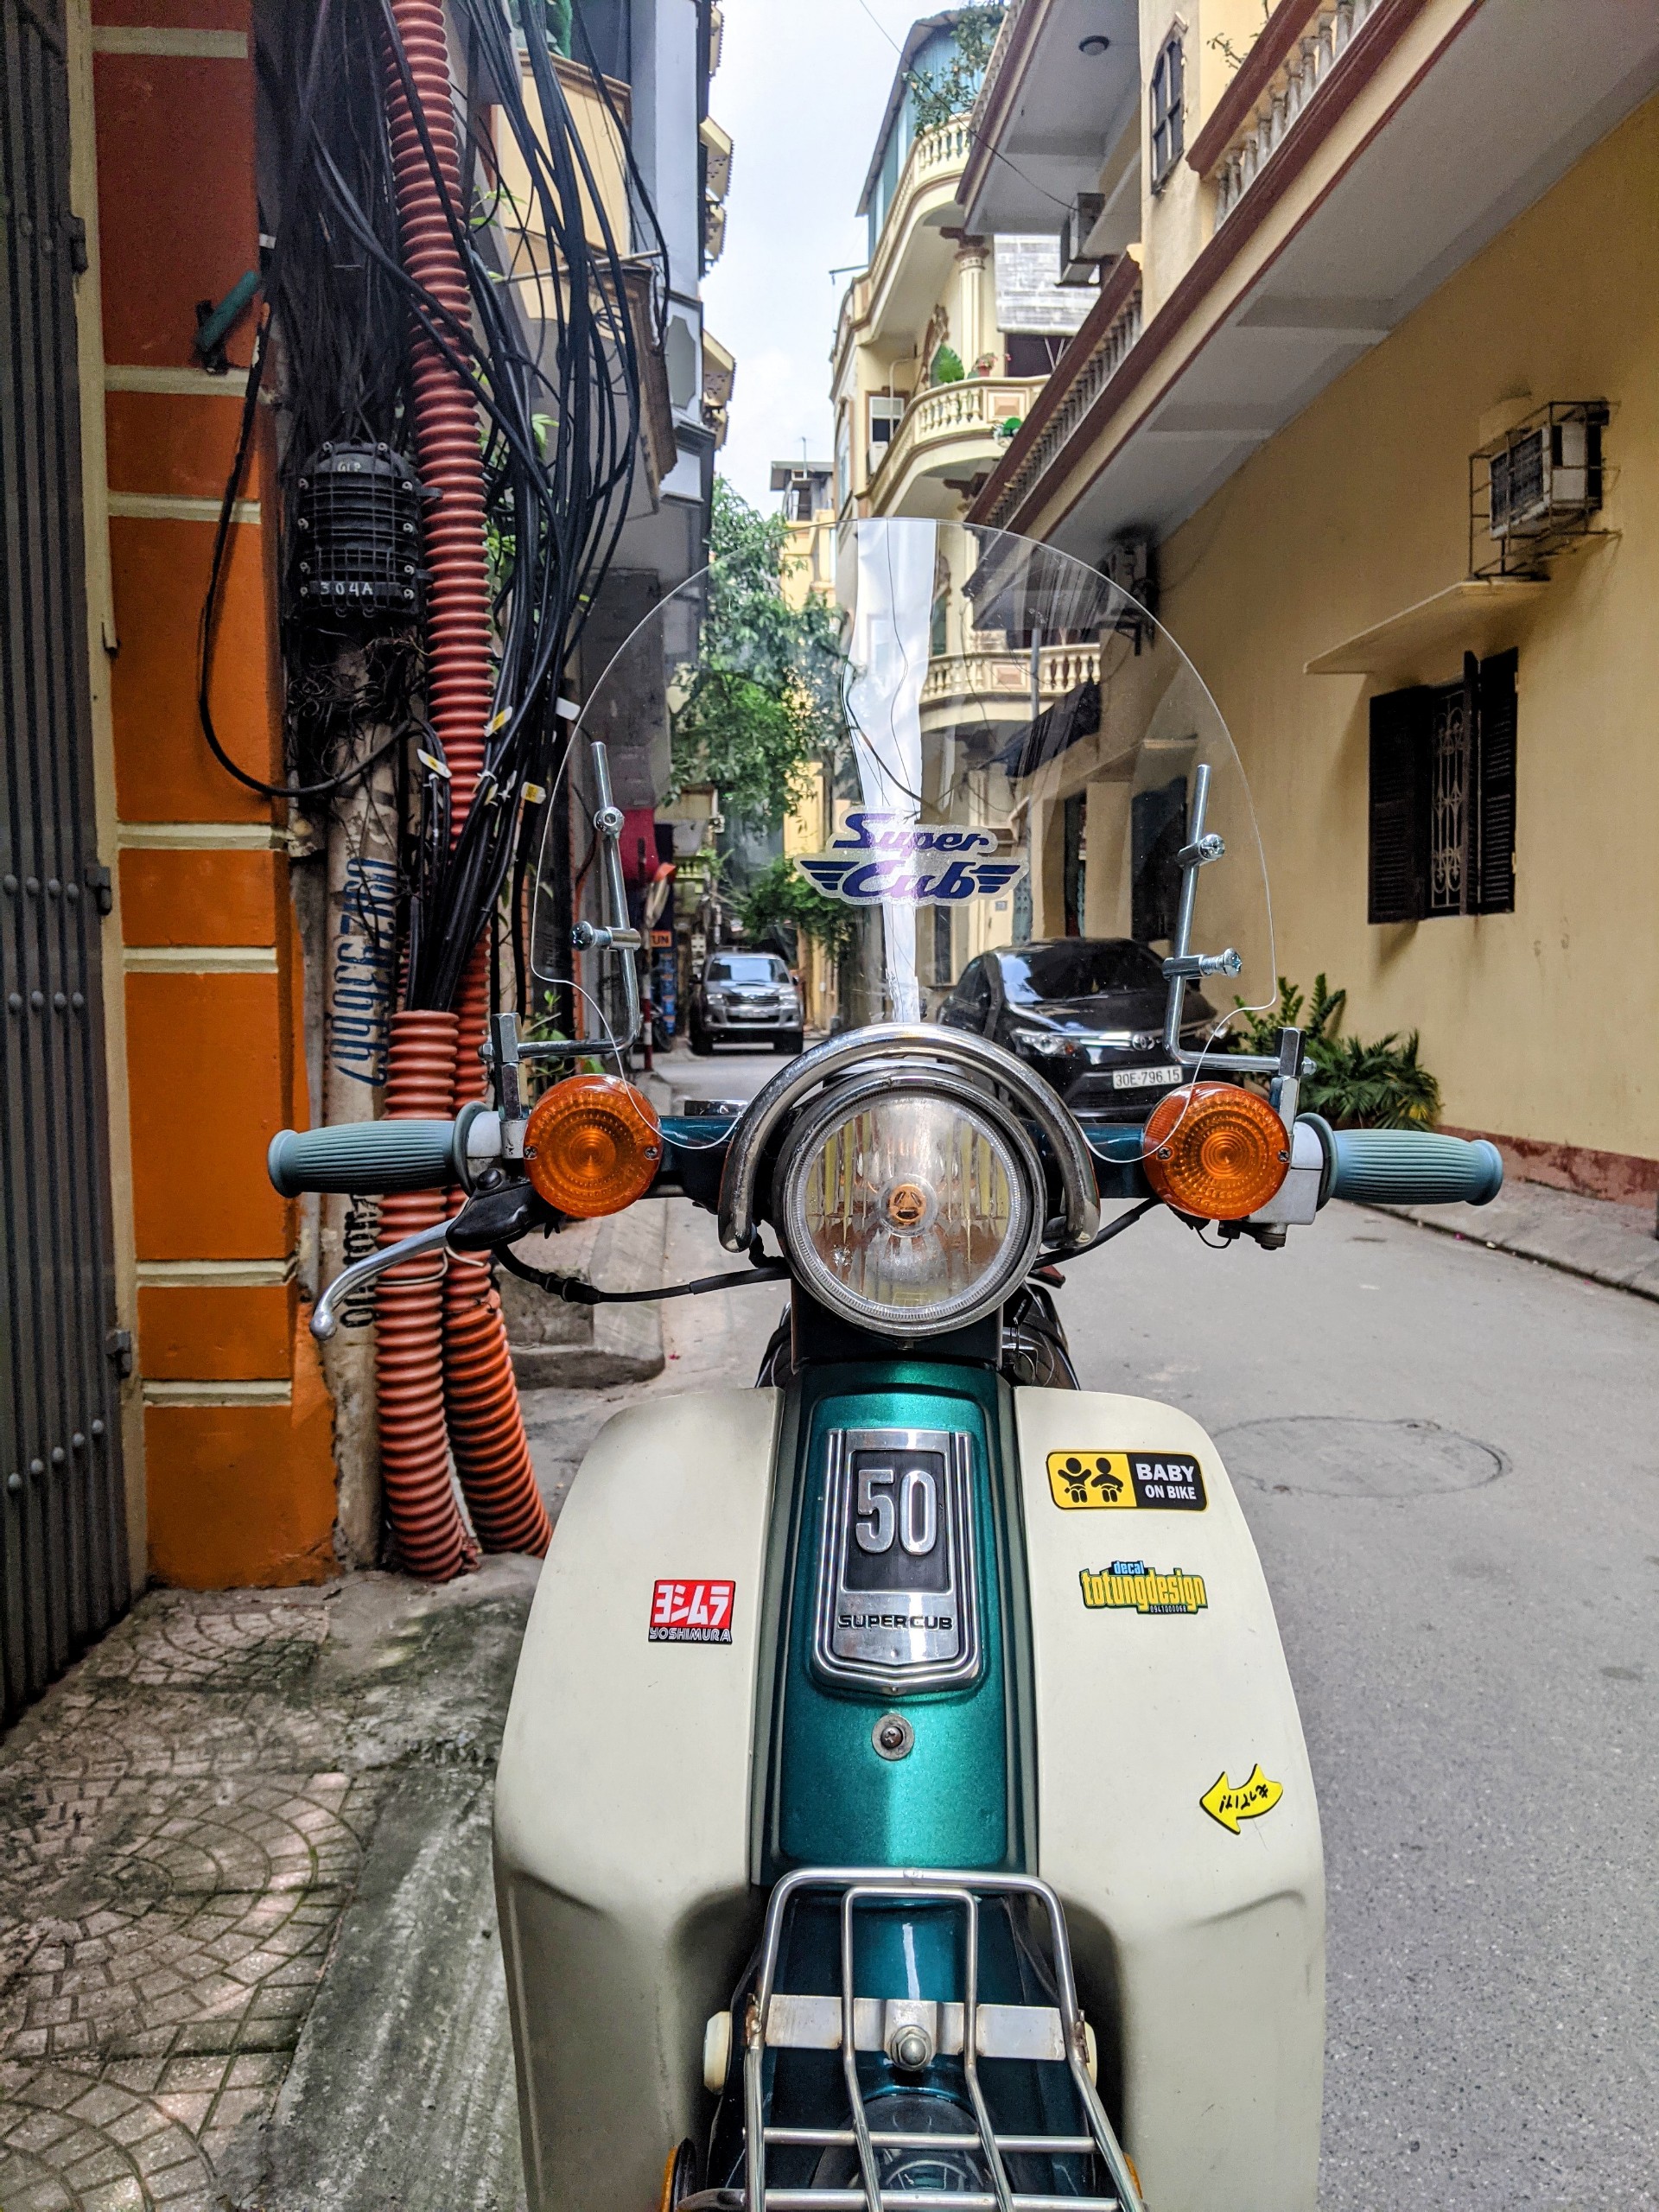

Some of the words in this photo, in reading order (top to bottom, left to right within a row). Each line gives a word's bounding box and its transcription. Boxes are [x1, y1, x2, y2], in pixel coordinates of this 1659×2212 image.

[321, 582, 373, 597] 304A
[832, 812, 989, 857] Super
[842, 860, 976, 899] Cub
[1135, 1463, 1194, 1483] BABY
[1145, 1484, 1165, 1499] ON
[1166, 1485, 1197, 1500] BIKE
[855, 1468, 938, 1555] 50
[1114, 1560, 1145, 1574] decal
[654, 1584, 730, 1626] ヨシムラ
[1081, 1569, 1206, 1612] totungdesign
[649, 1627, 732, 1642] YOSHIMURA
